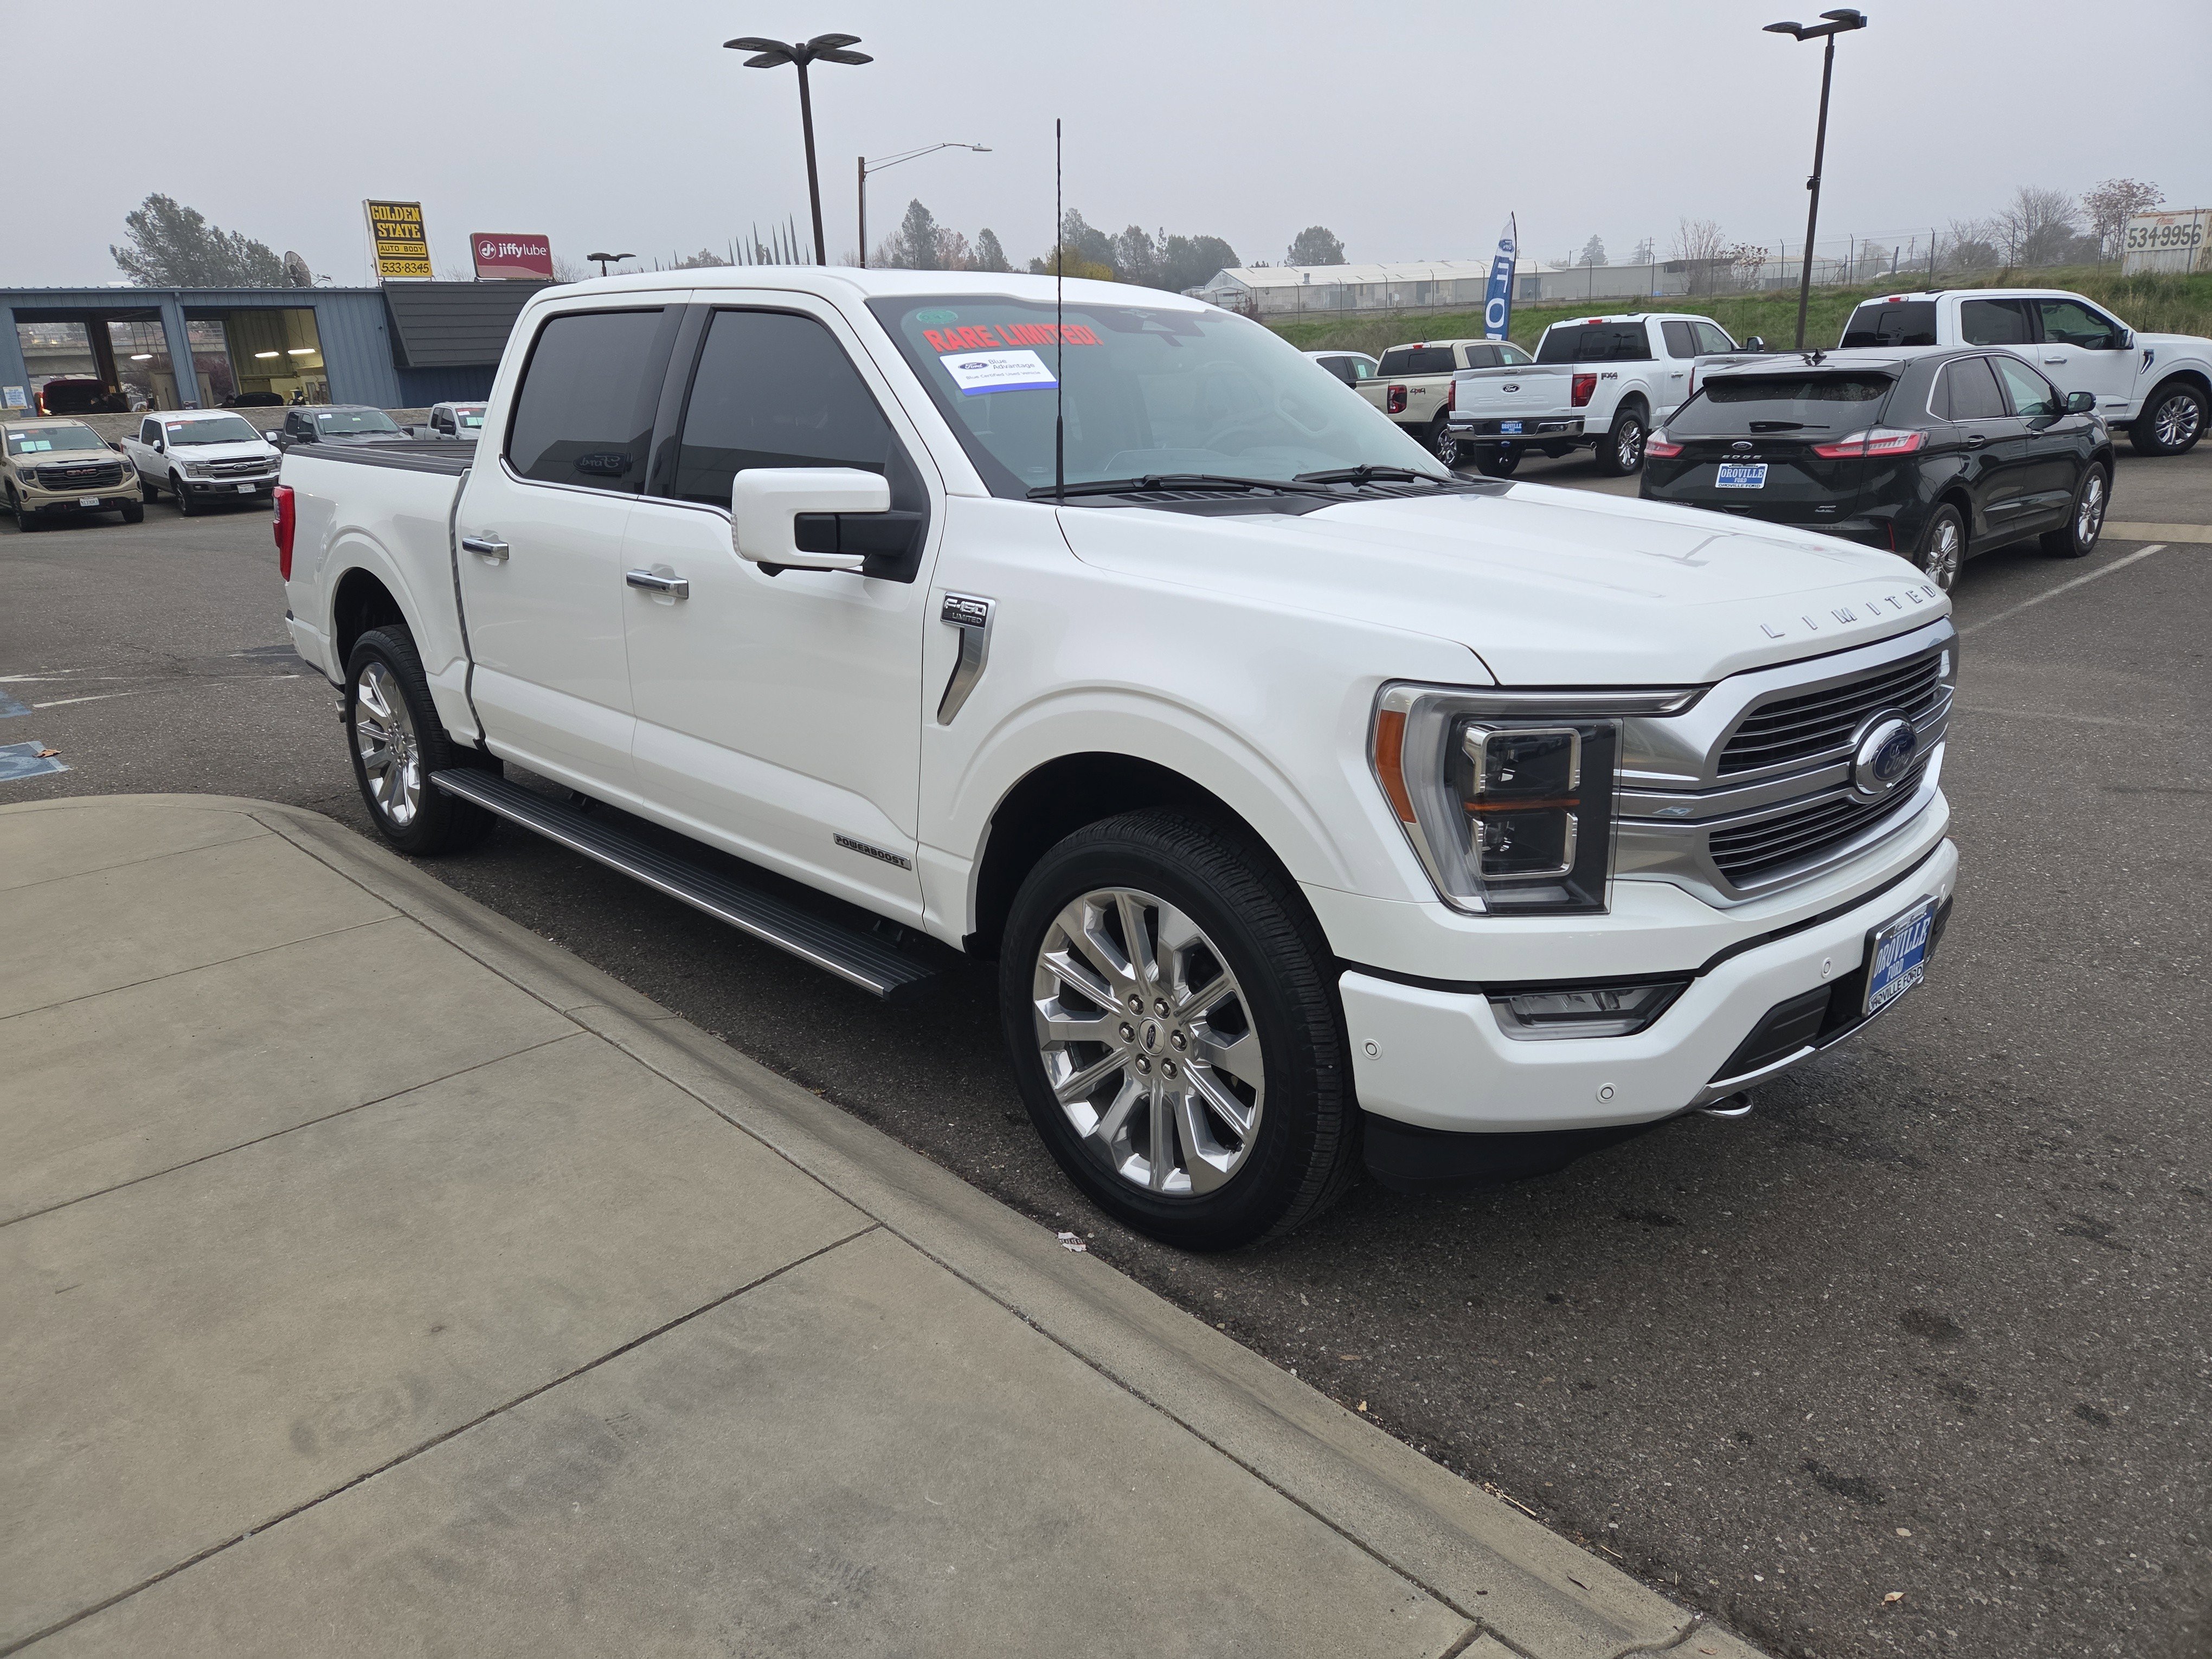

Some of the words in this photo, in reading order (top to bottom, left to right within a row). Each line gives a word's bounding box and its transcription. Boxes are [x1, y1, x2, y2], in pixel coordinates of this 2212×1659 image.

[370, 206, 421, 221] GOLDEN
[377, 222, 421, 237] STATE
[498, 243, 522, 258] jiffy
[523, 243, 546, 255] lube
[923, 325, 1001, 352] RARE
[994, 324, 1104, 346] LIMITED!
[1601, 372, 1618, 380] FX4
[1721, 468, 1764, 478] OROVILLE
[944, 598, 987, 616] F-150
[1760, 586, 1936, 639] LIMITED
[952, 612, 982, 624] LIMITED
[835, 835, 905, 866] POWERBOOST
[1874, 917, 1931, 979] OROVILLE
[1886, 958, 1904, 982] FORD
[1869, 979, 1901, 1012] OROVILLE
[1903, 966, 1922, 987] FORD
